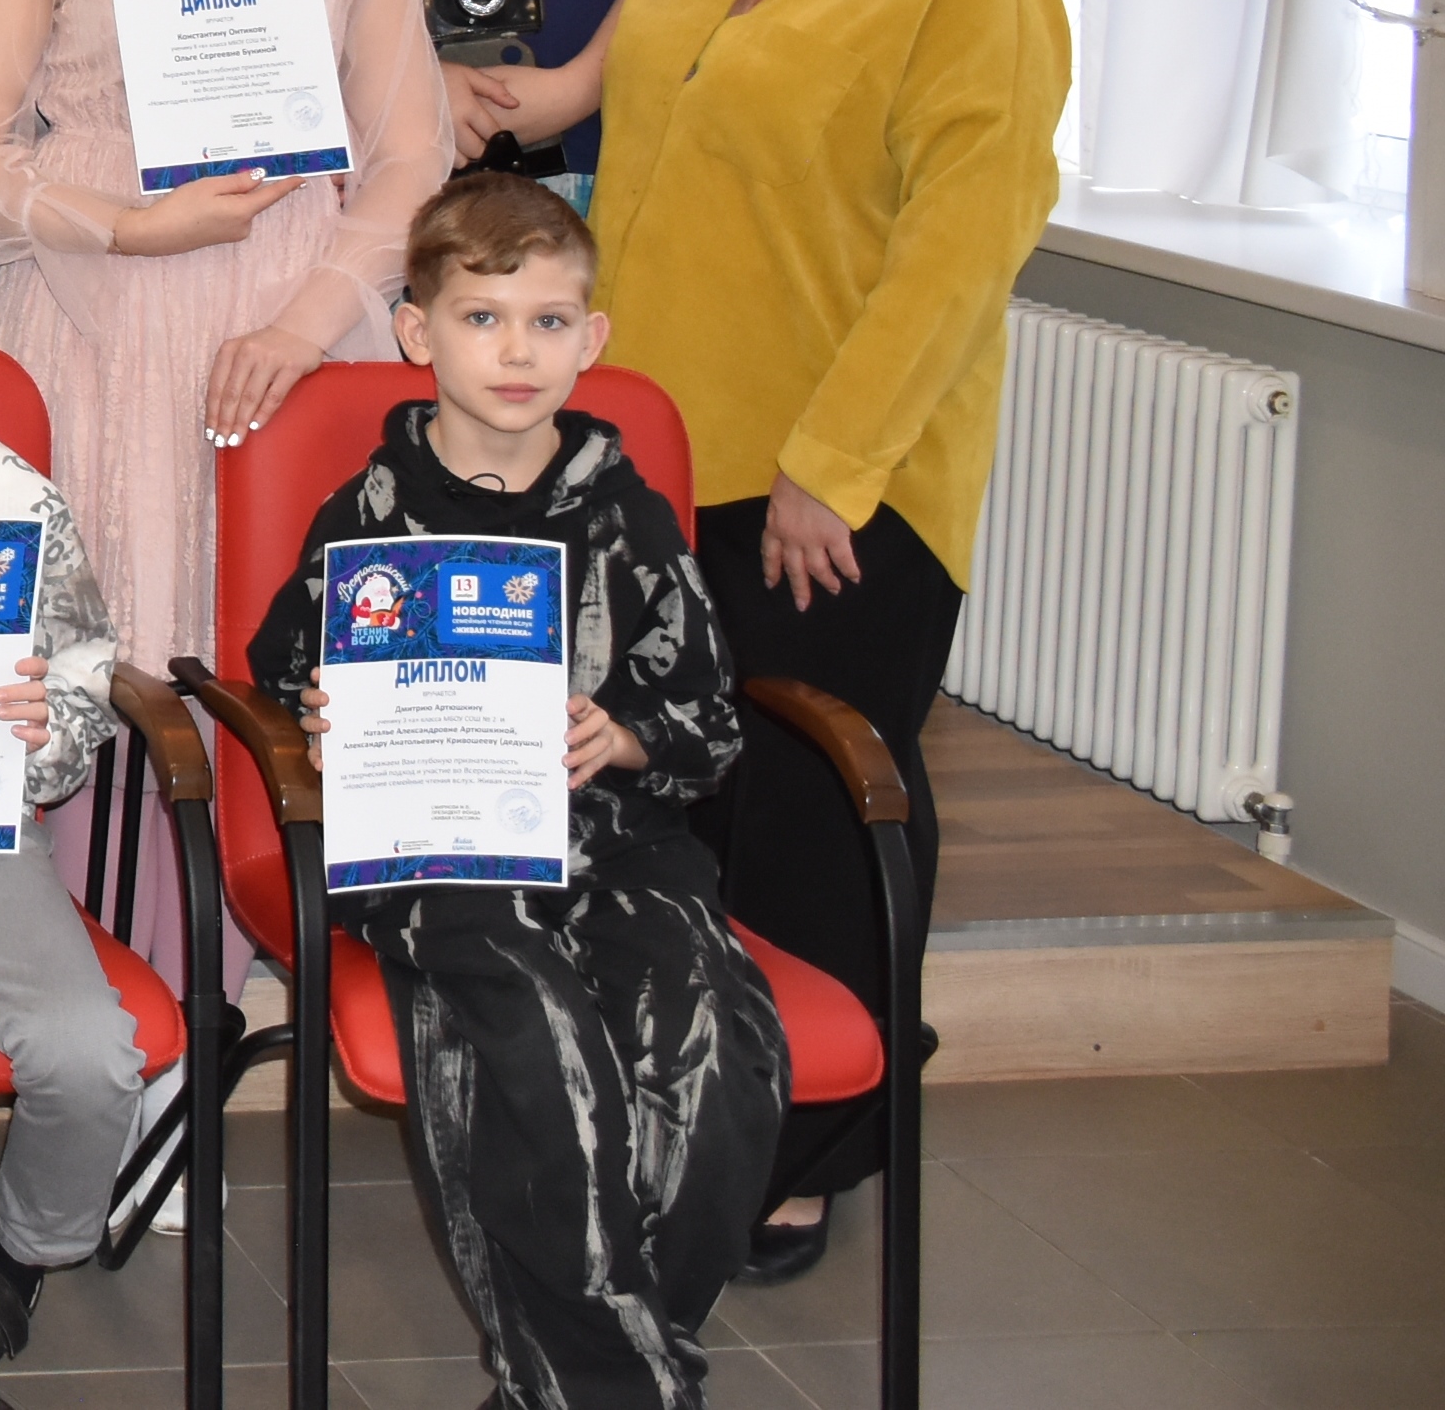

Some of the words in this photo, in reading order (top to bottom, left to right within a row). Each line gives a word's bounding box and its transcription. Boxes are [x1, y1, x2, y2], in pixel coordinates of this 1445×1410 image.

[455, 579, 472, 591] 13
[453, 606, 533, 619] НОВОГОДНИЕ
[351, 627, 388, 636] ЧТЕНИЯ
[452, 626, 483, 635] «ЖИВАЯ
[485, 627, 532, 637] КЛАССИКА»
[351, 635, 389, 646] ВСЛУХ
[395, 661, 485, 688] ДИПЛОМ
